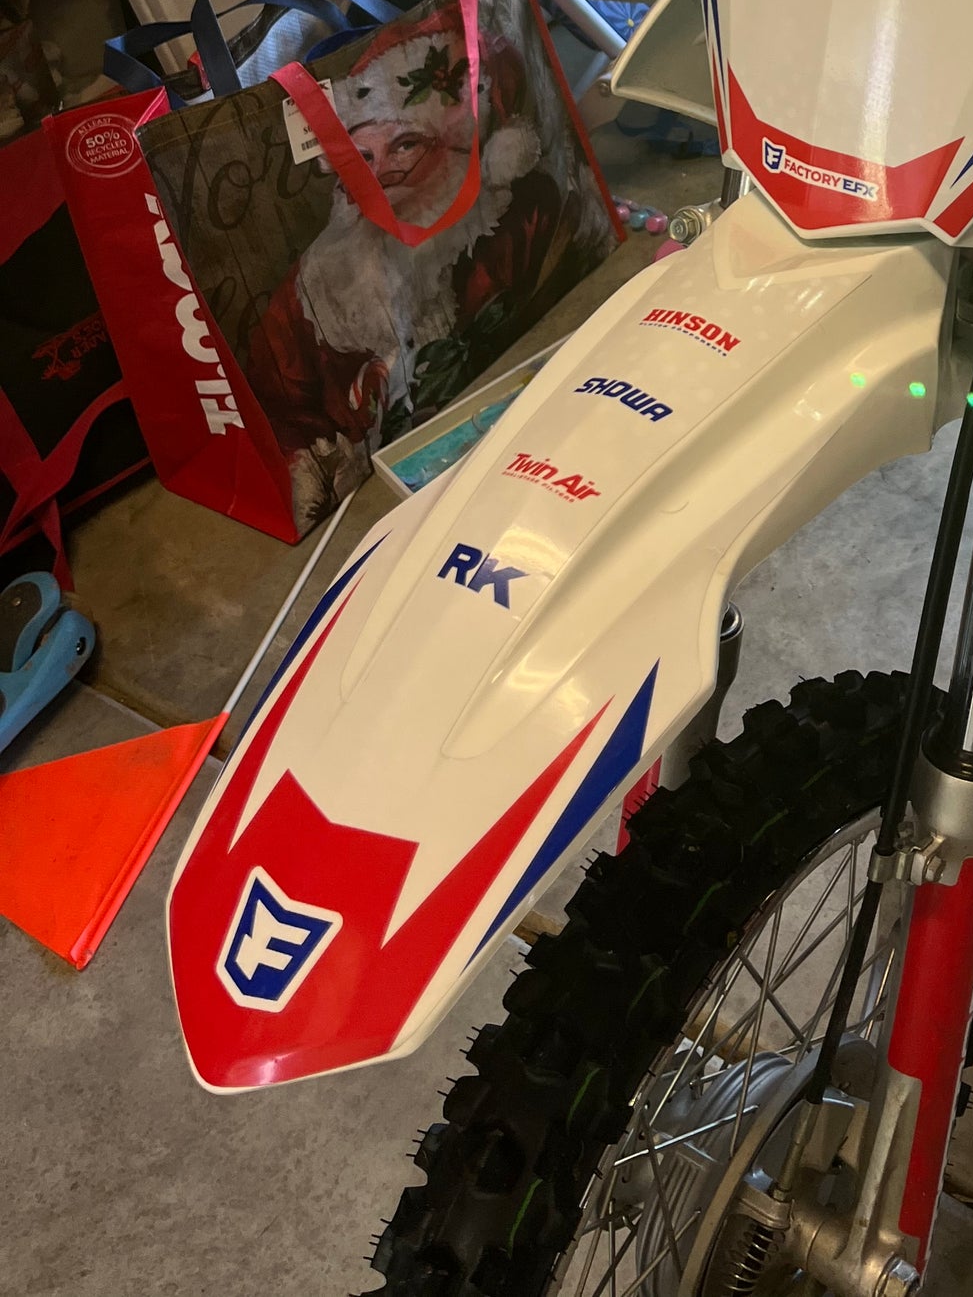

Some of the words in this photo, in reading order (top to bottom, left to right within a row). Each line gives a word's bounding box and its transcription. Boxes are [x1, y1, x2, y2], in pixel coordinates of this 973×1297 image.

[86, 129, 120, 148] 50%
[87, 118, 112, 131] LEAST
[86, 139, 127, 157] RECYCLED
[90, 148, 129, 164] MATERIAL
[784, 158, 841, 187] FACTORY
[843, 178, 874, 198] EFX
[642, 308, 741, 352] HINSON
[574, 377, 673, 422] SHOWA
[506, 453, 559, 481] Twin
[551, 474, 601, 500] Air
[437, 543, 530, 610] RK
